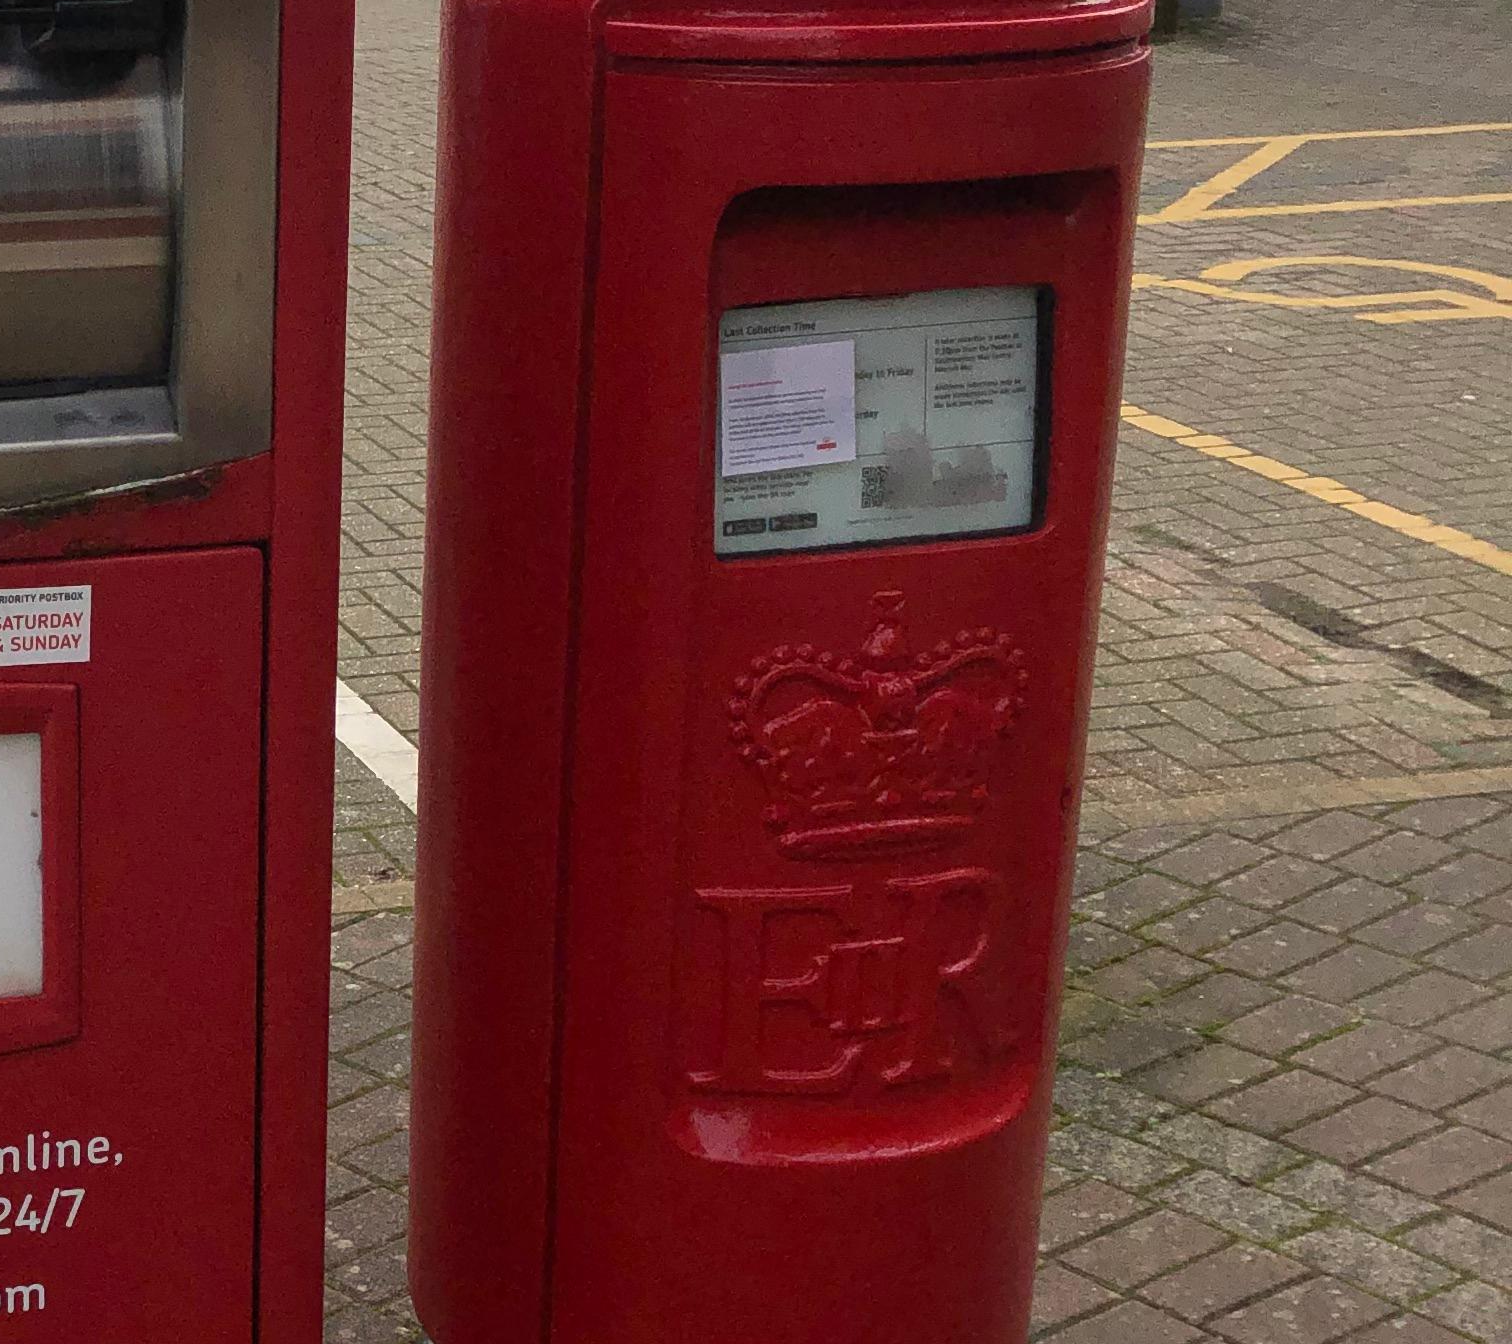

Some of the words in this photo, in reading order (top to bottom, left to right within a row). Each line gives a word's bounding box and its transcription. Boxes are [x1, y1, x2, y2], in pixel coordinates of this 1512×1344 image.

[723, 328, 744, 338] Last
[745, 324, 791, 336] Collection
[793, 321, 816, 332] Time
[887, 366, 914, 378] Friday
[38, 591, 84, 603] POSTBOX
[10, 633, 83, 652] SUNDAY
